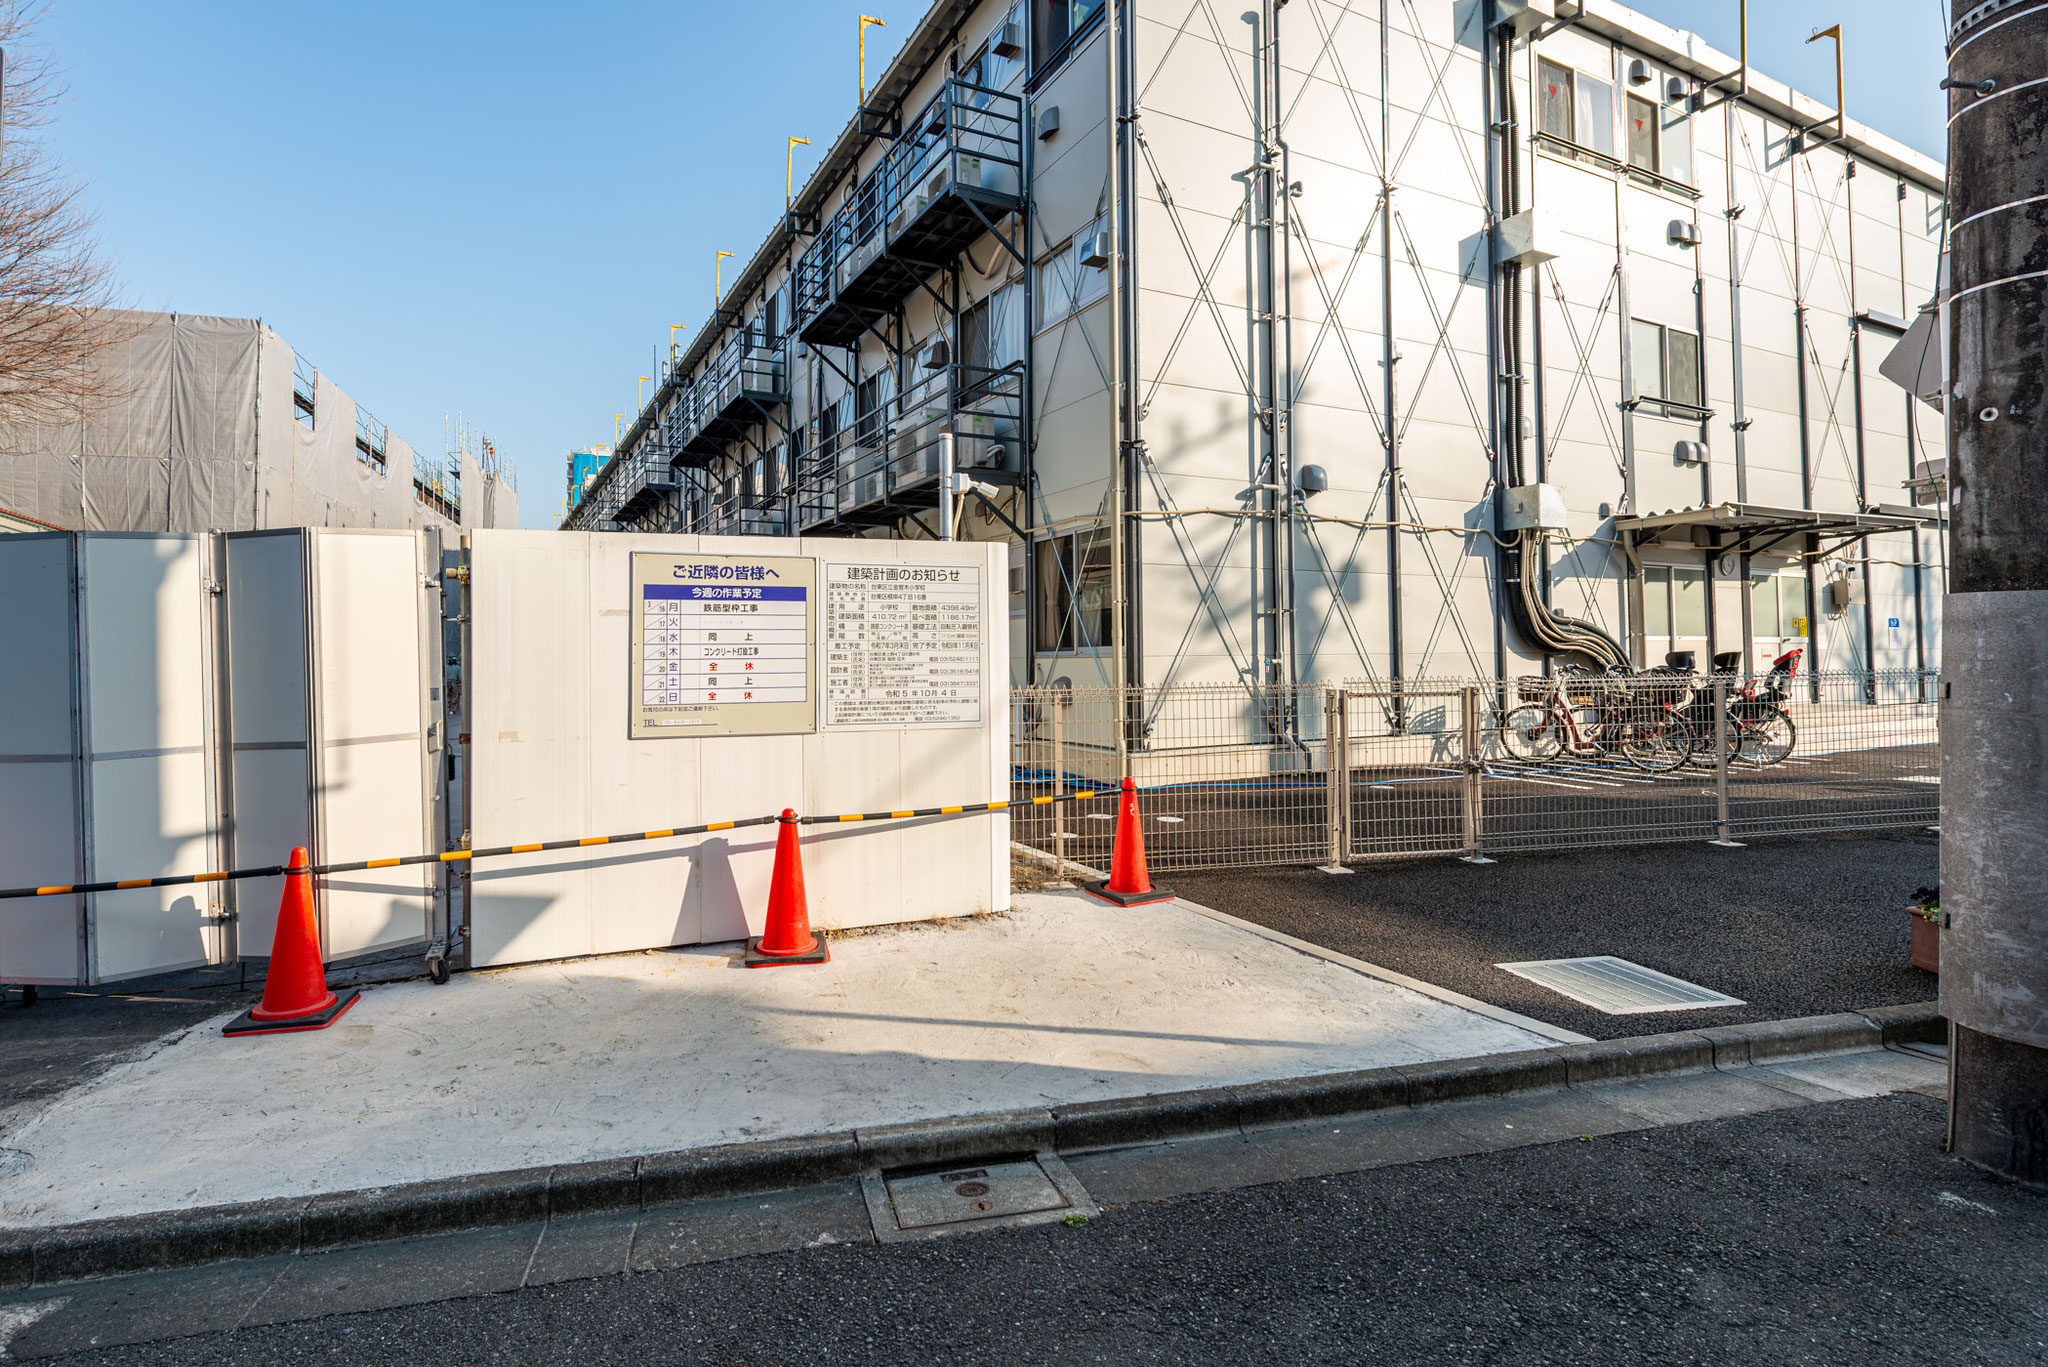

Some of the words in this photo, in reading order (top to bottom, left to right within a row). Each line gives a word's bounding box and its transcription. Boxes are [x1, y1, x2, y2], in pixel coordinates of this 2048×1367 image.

[673, 564, 780, 580] ご近隣の皆様へ
[847, 567, 960, 582] 建築計画のお知らせ
[692, 587, 762, 599] 今週の作業予定
[669, 603, 678, 612] 月
[703, 603, 758, 613] 鉄筋型枠工事
[669, 618, 678, 626] 火
[669, 633, 678, 641] 水
[669, 648, 678, 656] 木
[669, 662, 678, 671] 金
[669, 678, 678, 686] 土
[669, 692, 677, 702] 日
[643, 719, 657, 727] TEL
